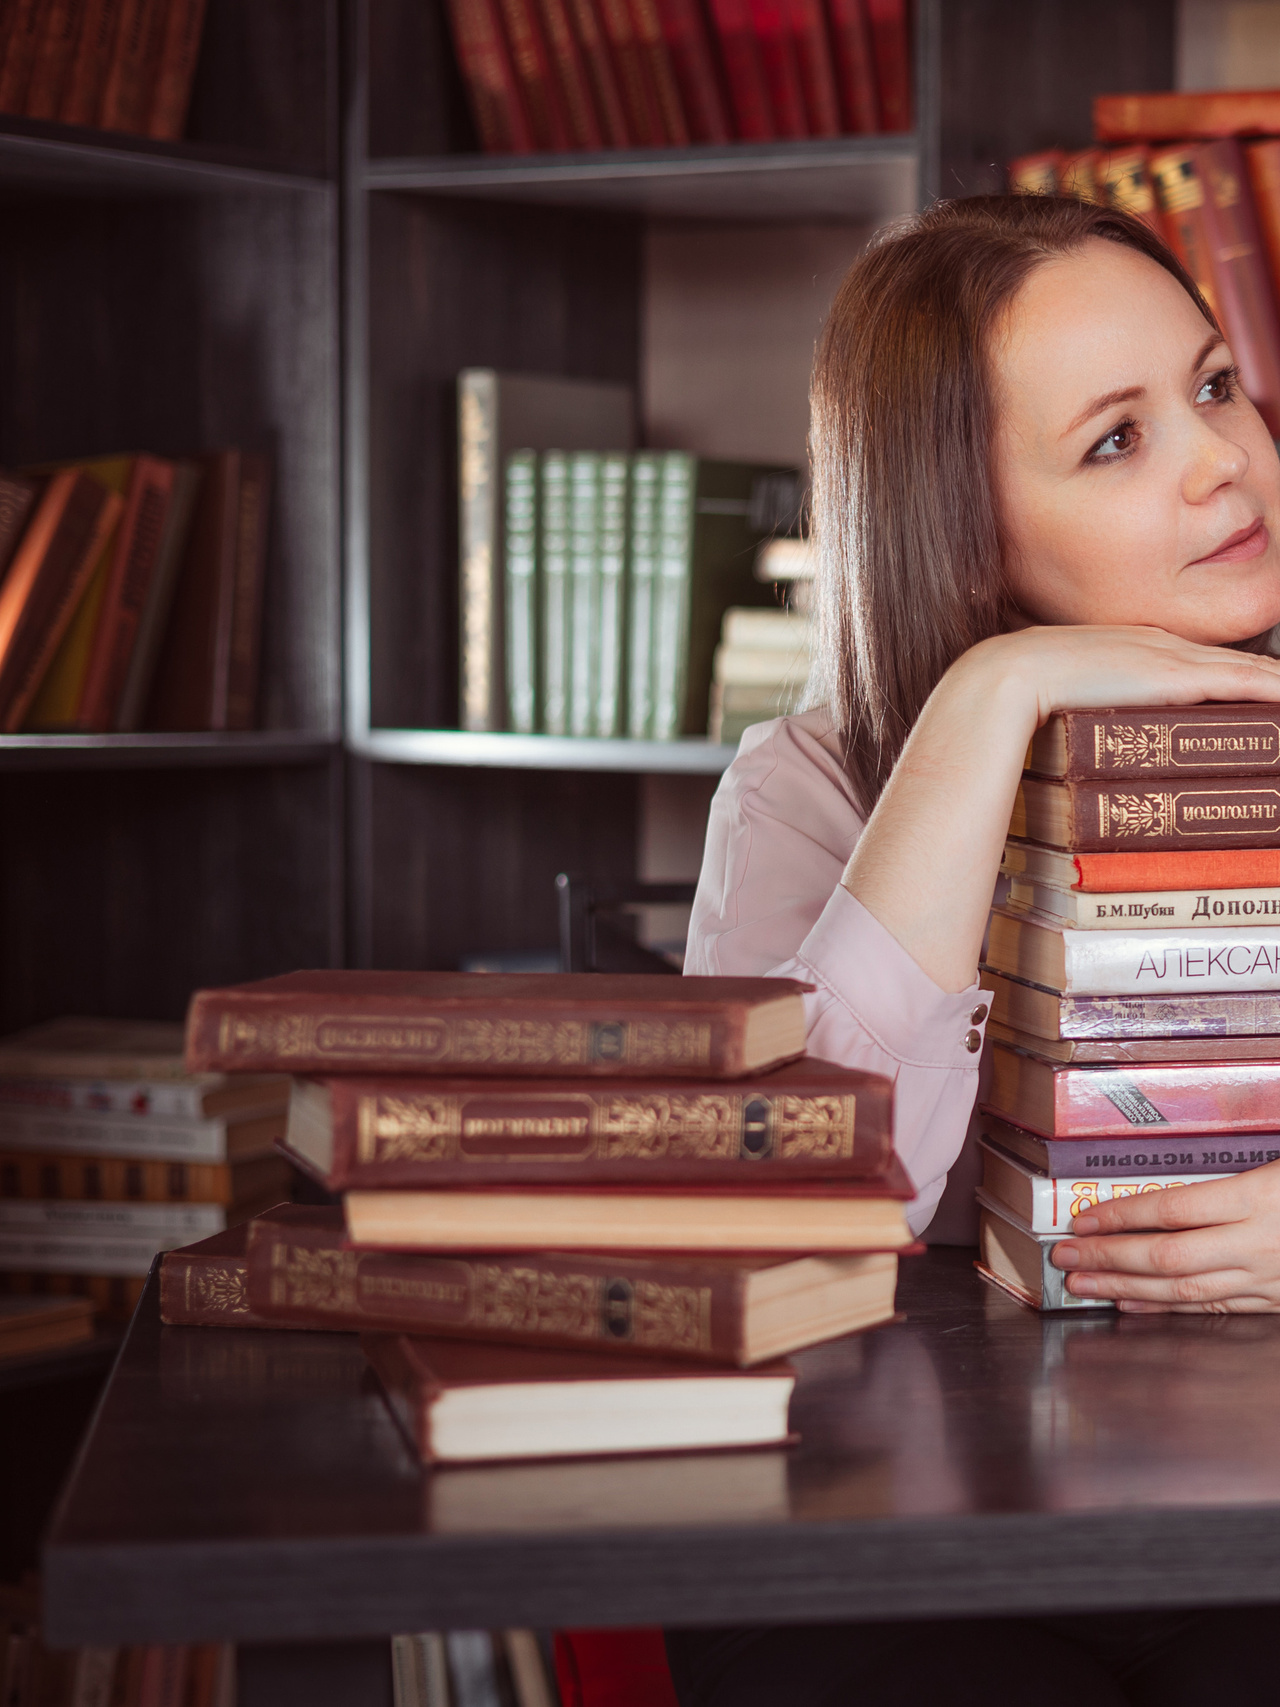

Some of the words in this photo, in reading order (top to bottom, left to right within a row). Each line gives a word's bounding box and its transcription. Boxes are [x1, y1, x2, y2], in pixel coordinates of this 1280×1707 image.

[1182, 803, 1278, 821] Л.Н.ТОЛСТОЙ
[1096, 903, 1175, 920] Б.М.Шубин
[1143, 1101, 1162, 1121] РОМАН
[1086, 1151, 1193, 1168] ИСТОРИИ
[1202, 1150, 1280, 1165] ВИТОК
